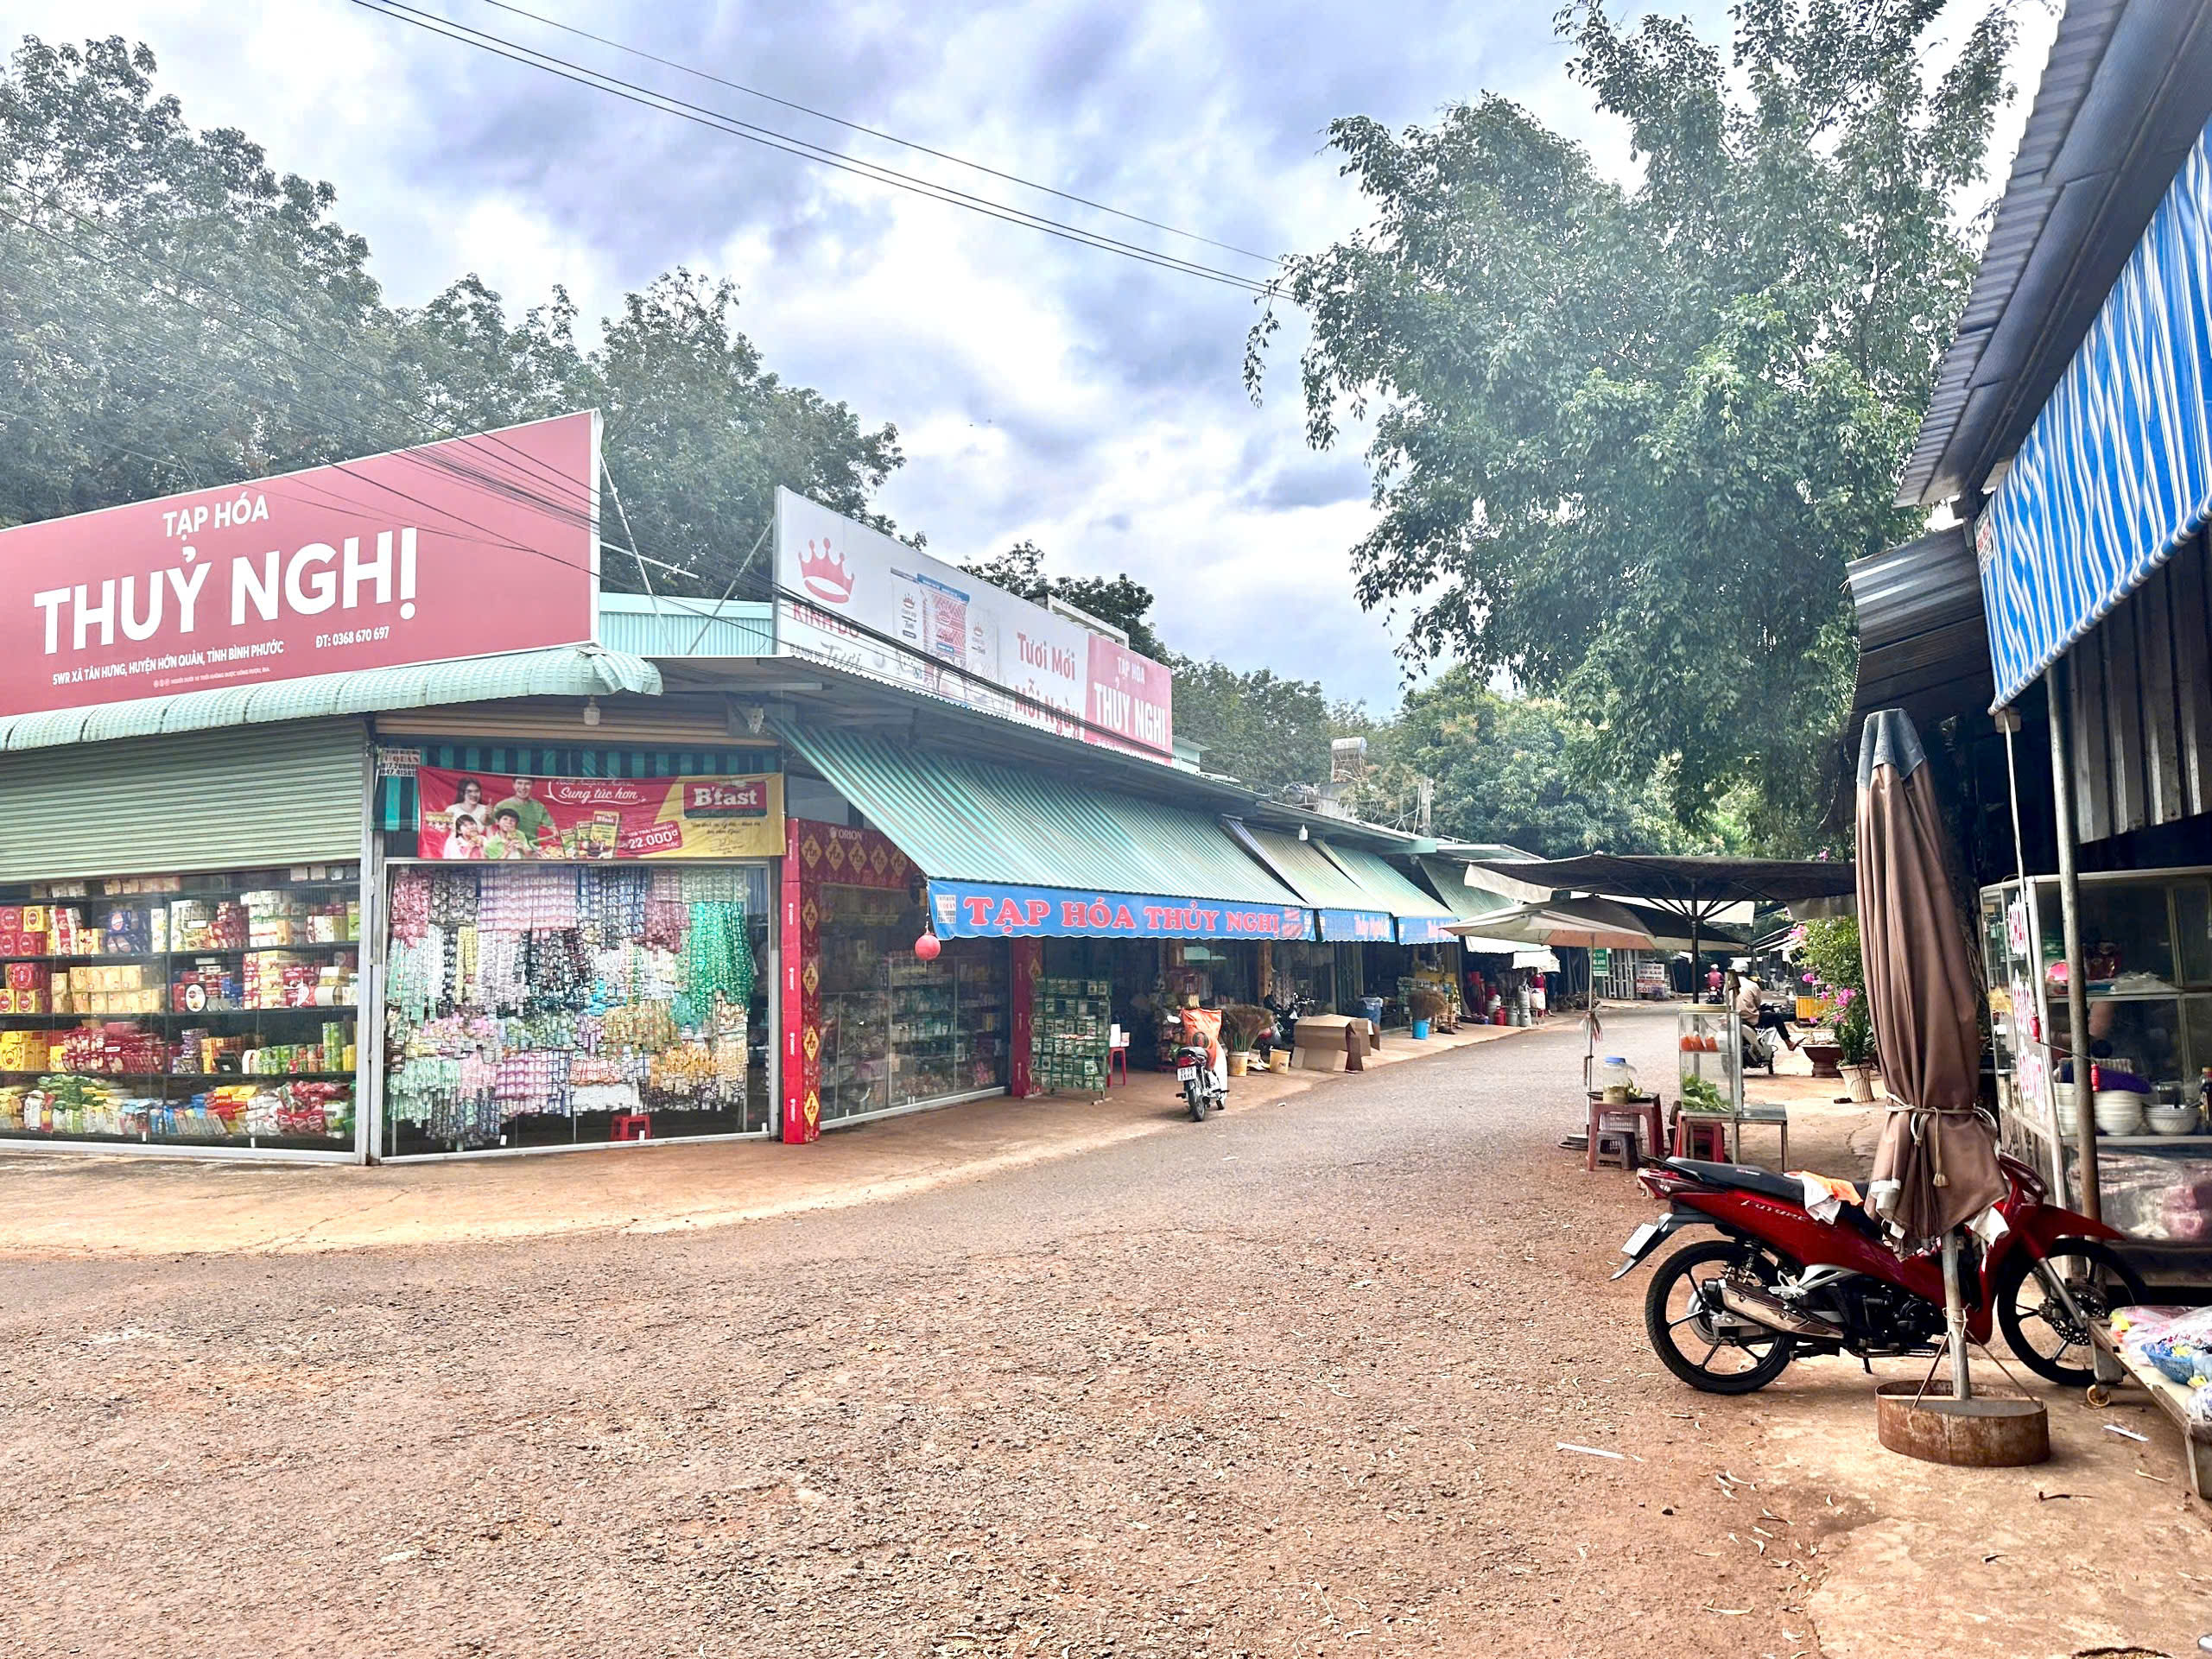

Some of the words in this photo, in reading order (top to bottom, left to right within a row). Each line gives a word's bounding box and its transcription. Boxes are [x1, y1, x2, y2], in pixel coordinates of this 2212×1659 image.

[162, 507, 208, 541] TẠP
[214, 494, 269, 526] HÓA
[230, 527, 418, 620] NGHỊ
[332, 630, 354, 646] 0368
[355, 628, 372, 643] 670
[373, 625, 390, 640] 697
[1017, 631, 1048, 670] Tươi
[1052, 647, 1076, 681] Mới
[71, 668, 83, 683] XÃ
[84, 665, 100, 681] TÂN
[101, 662, 128, 678] HƯNG,
[129, 657, 156, 675] HUYỆN
[250, 638, 284, 657] PHƯỚC
[560, 788, 592, 804] Sung
[614, 787, 637, 800] hơn
[963, 896, 1051, 934] TẠP
[1061, 896, 1136, 928] HÓA
[1144, 901, 1220, 932] THỦY
[1226, 911, 1280, 939] NGHỊ
